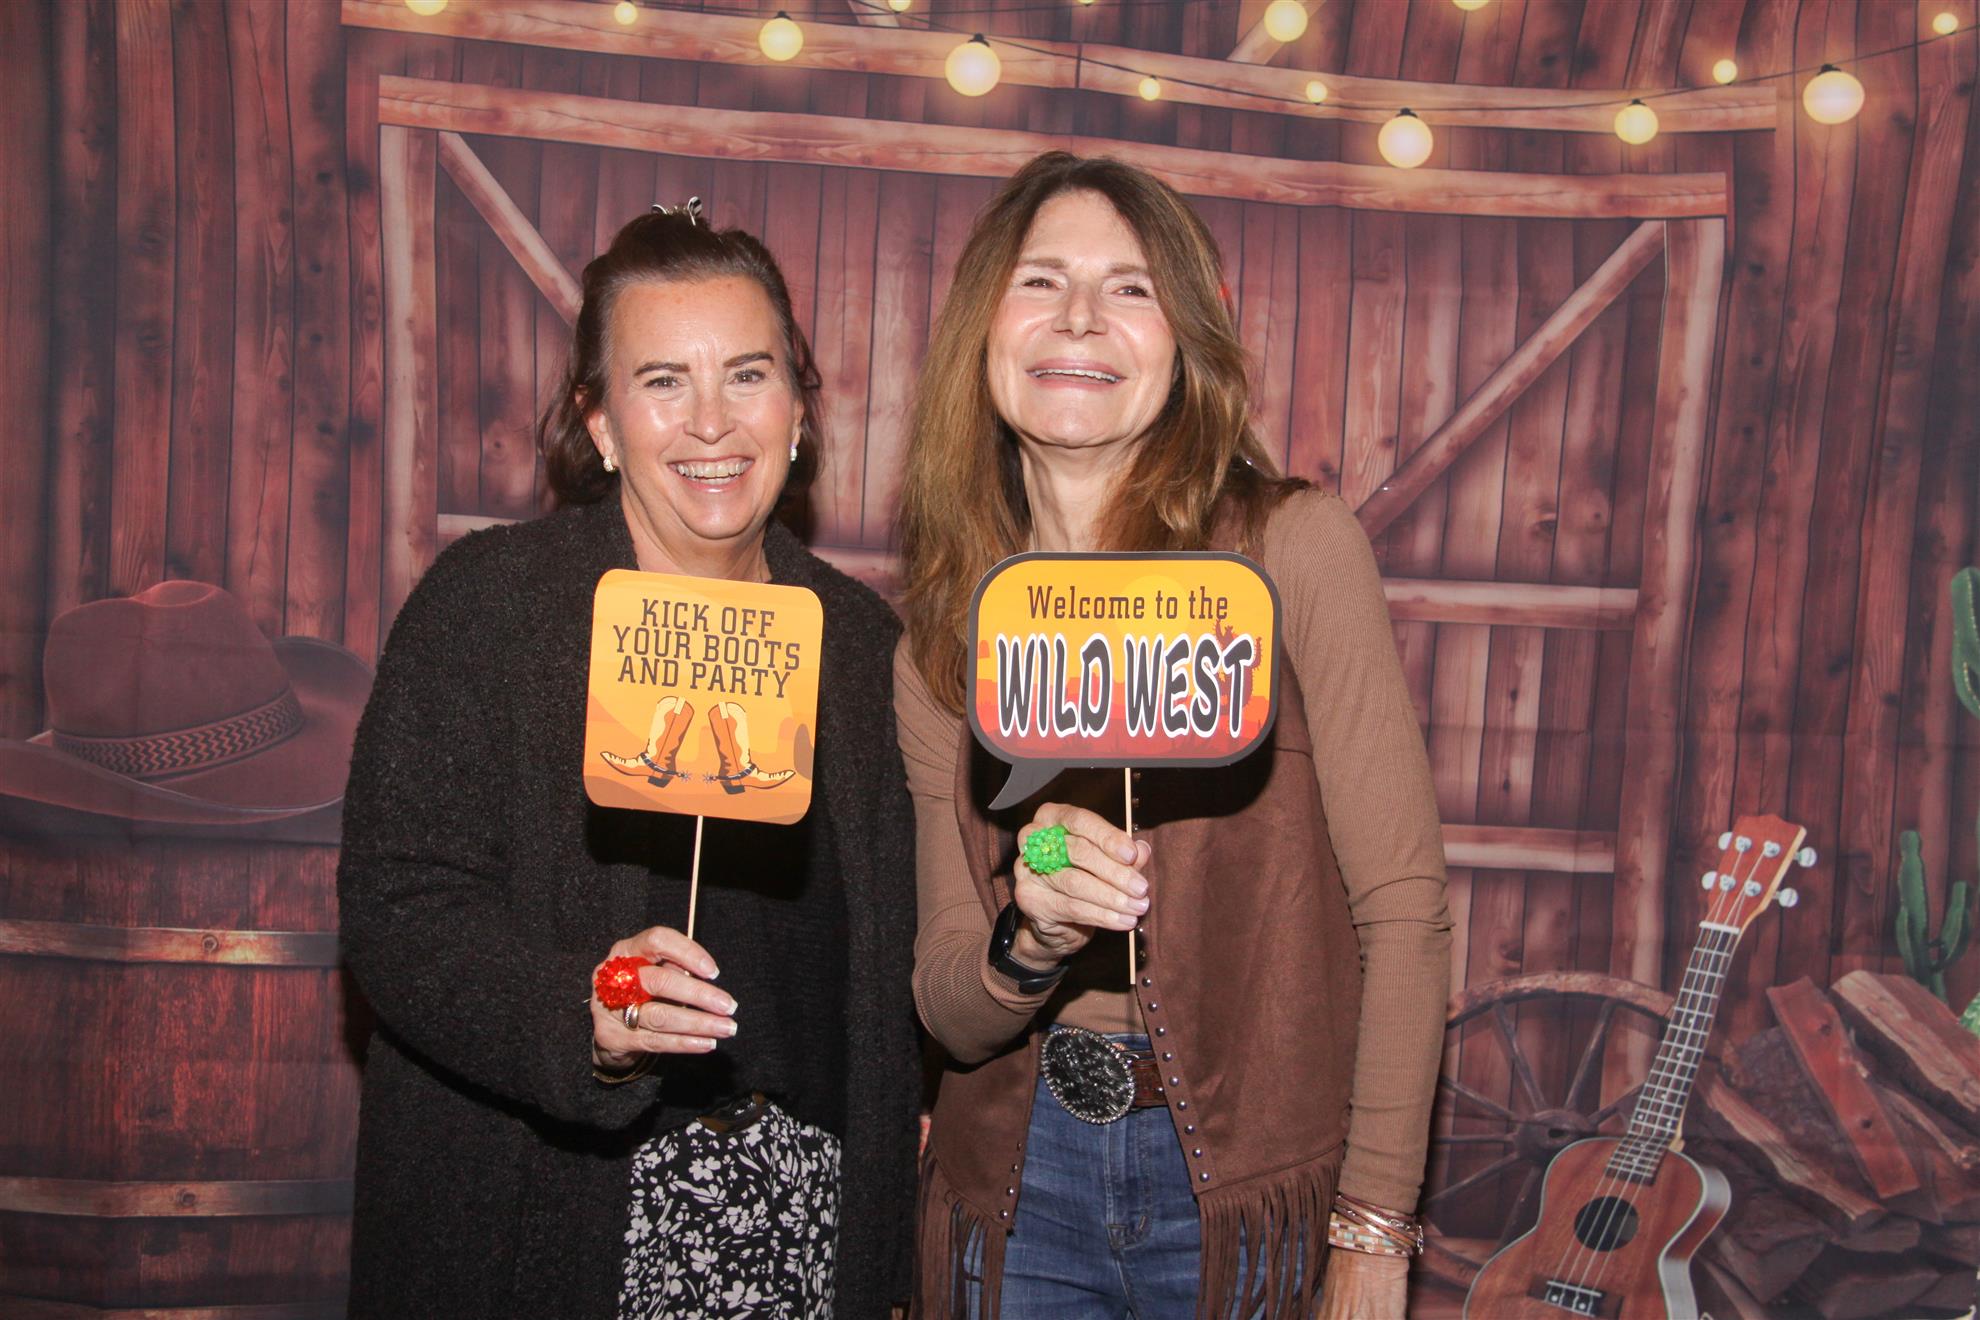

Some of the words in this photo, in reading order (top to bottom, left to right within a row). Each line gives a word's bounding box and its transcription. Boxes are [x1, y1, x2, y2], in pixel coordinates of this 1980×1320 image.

[641, 598, 710, 632] KICK
[720, 606, 775, 638] OFF
[1027, 585, 1145, 620] Welcome
[1155, 590, 1178, 620] to
[1189, 585, 1229, 620] the
[613, 625, 691, 660] YOUR
[702, 634, 801, 671] BOOTS
[617, 655, 679, 688] AND
[689, 662, 791, 698] PARTY
[996, 633, 1112, 738] WILD
[1124, 633, 1254, 738] WEST
